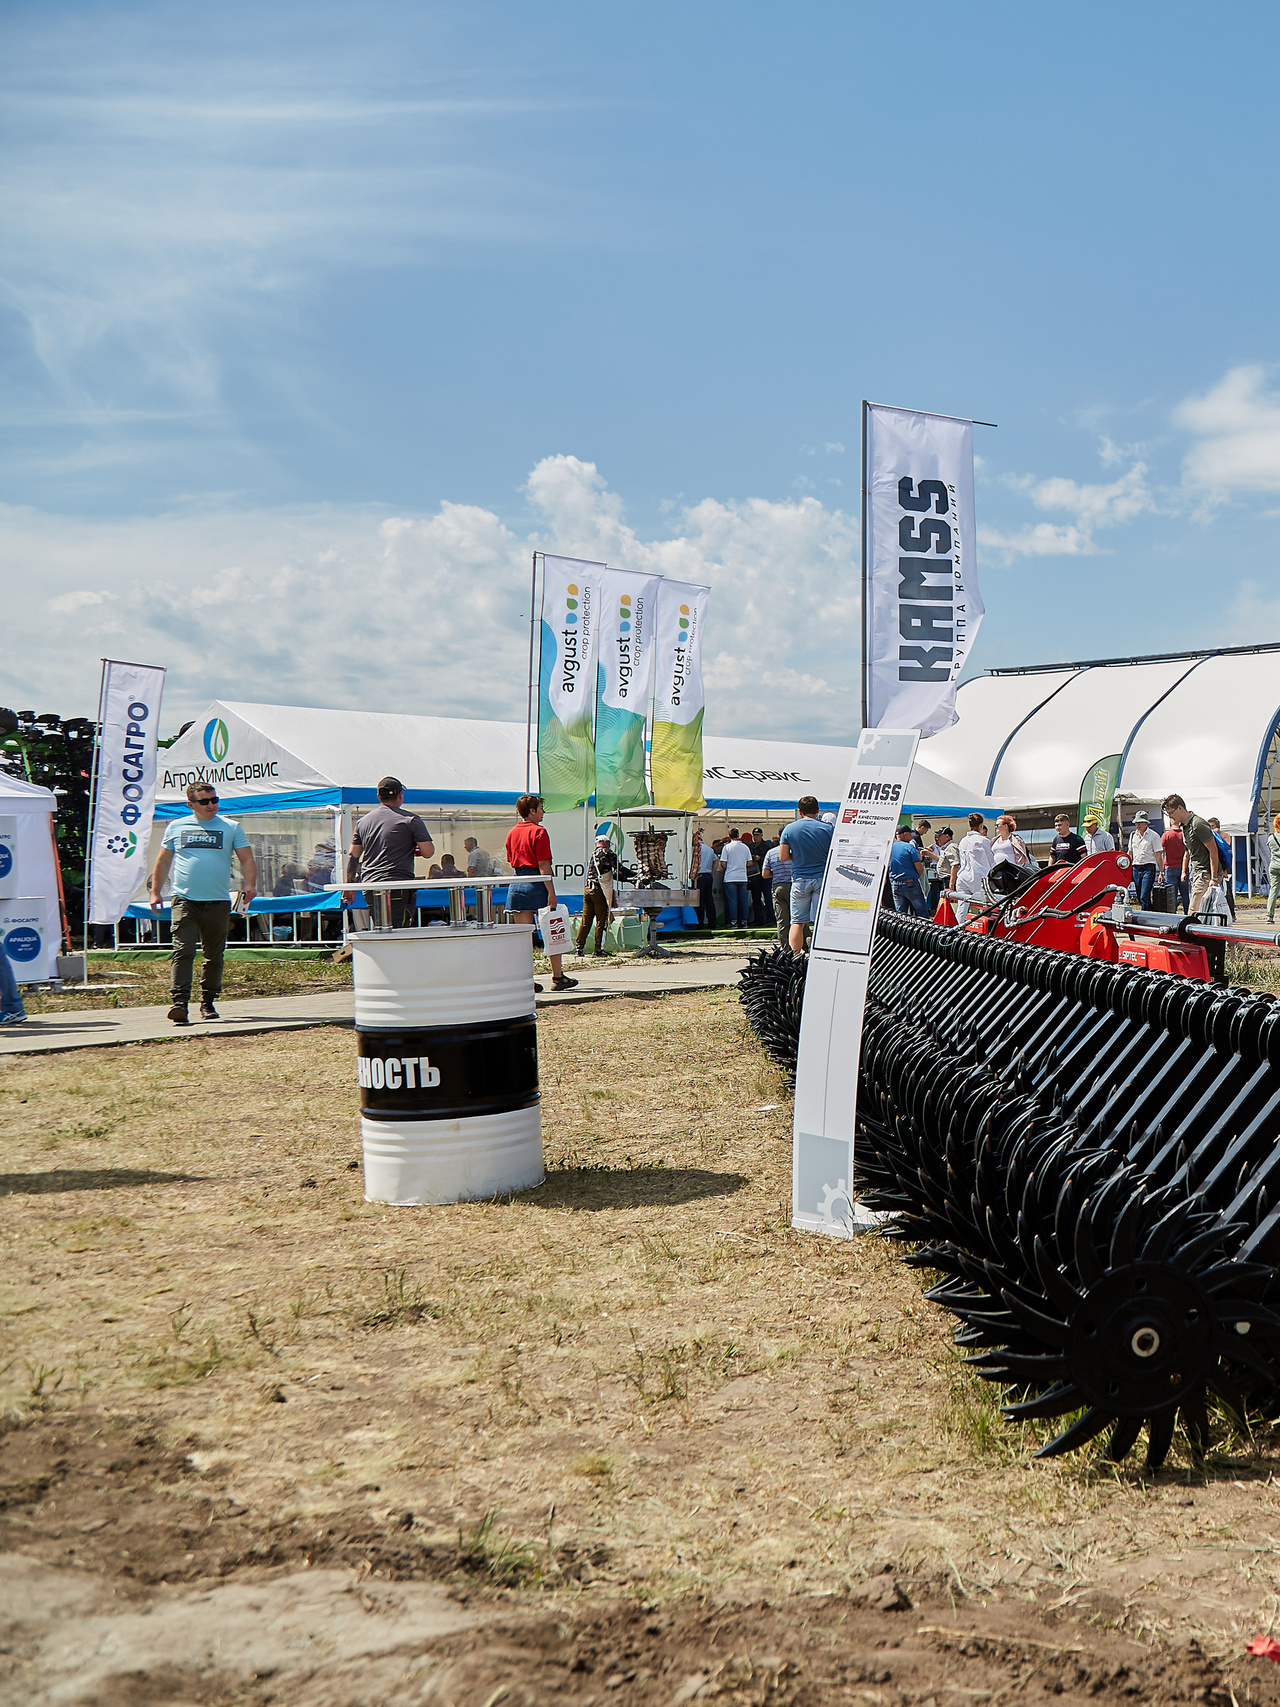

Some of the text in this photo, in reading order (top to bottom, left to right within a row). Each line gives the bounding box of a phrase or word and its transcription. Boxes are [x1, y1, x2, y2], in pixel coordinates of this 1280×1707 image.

[898, 476, 954, 682] KAMSS
[947, 483, 966, 682] ГРУППА КОМПАНИЙ
[581, 586, 591, 660] crop protection
[633, 597, 644, 667] crop protection
[562, 629, 580, 693] avgust
[616, 637, 632, 698] avgust
[671, 647, 686, 706] avgust
[685, 655, 693, 676] crop
[121, 702, 149, 826] ФОСАГРО
[162, 761, 279, 791] АгроХимСервис
[847, 782, 902, 801] KAMSS
